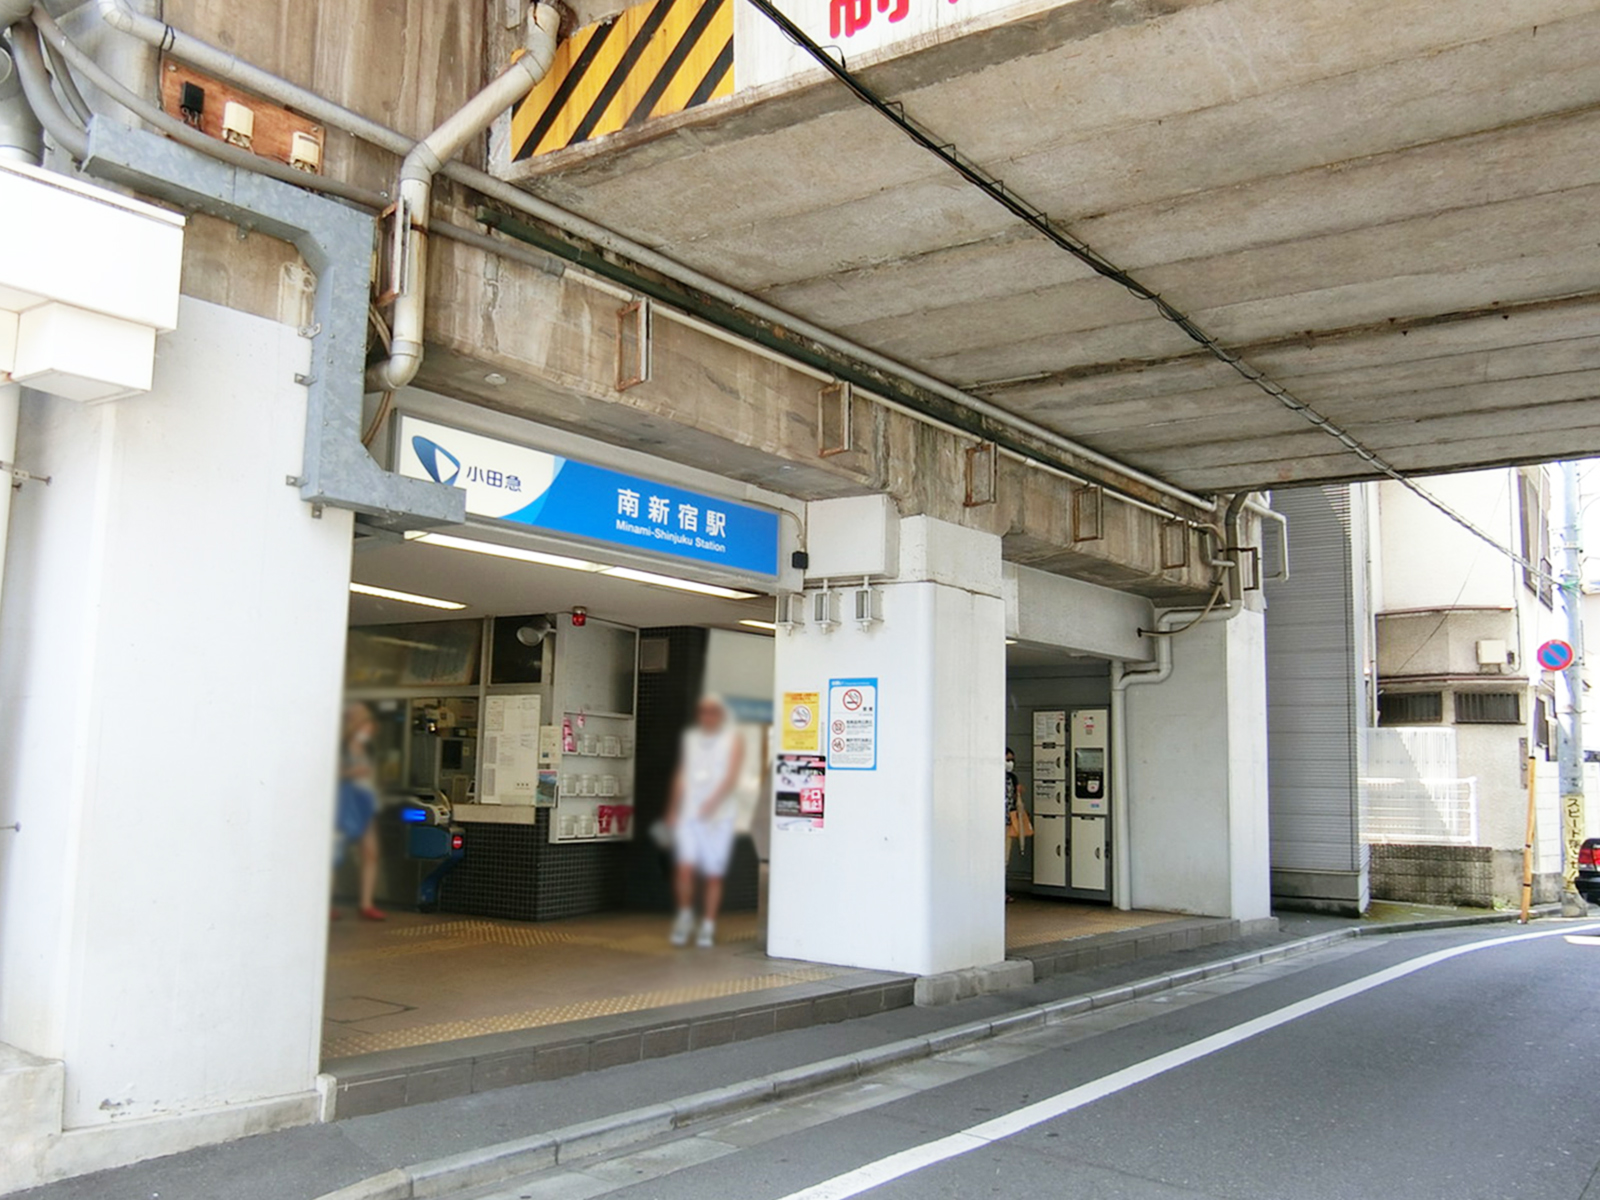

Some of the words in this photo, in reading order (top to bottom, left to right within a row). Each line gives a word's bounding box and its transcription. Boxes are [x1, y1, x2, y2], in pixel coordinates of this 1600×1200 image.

[466, 466, 522, 492] 小田急
[617, 488, 726, 538] 南新宿駅
[616, 519, 694, 546] Minami-Shinjuku
[695, 537, 727, 553] Station
